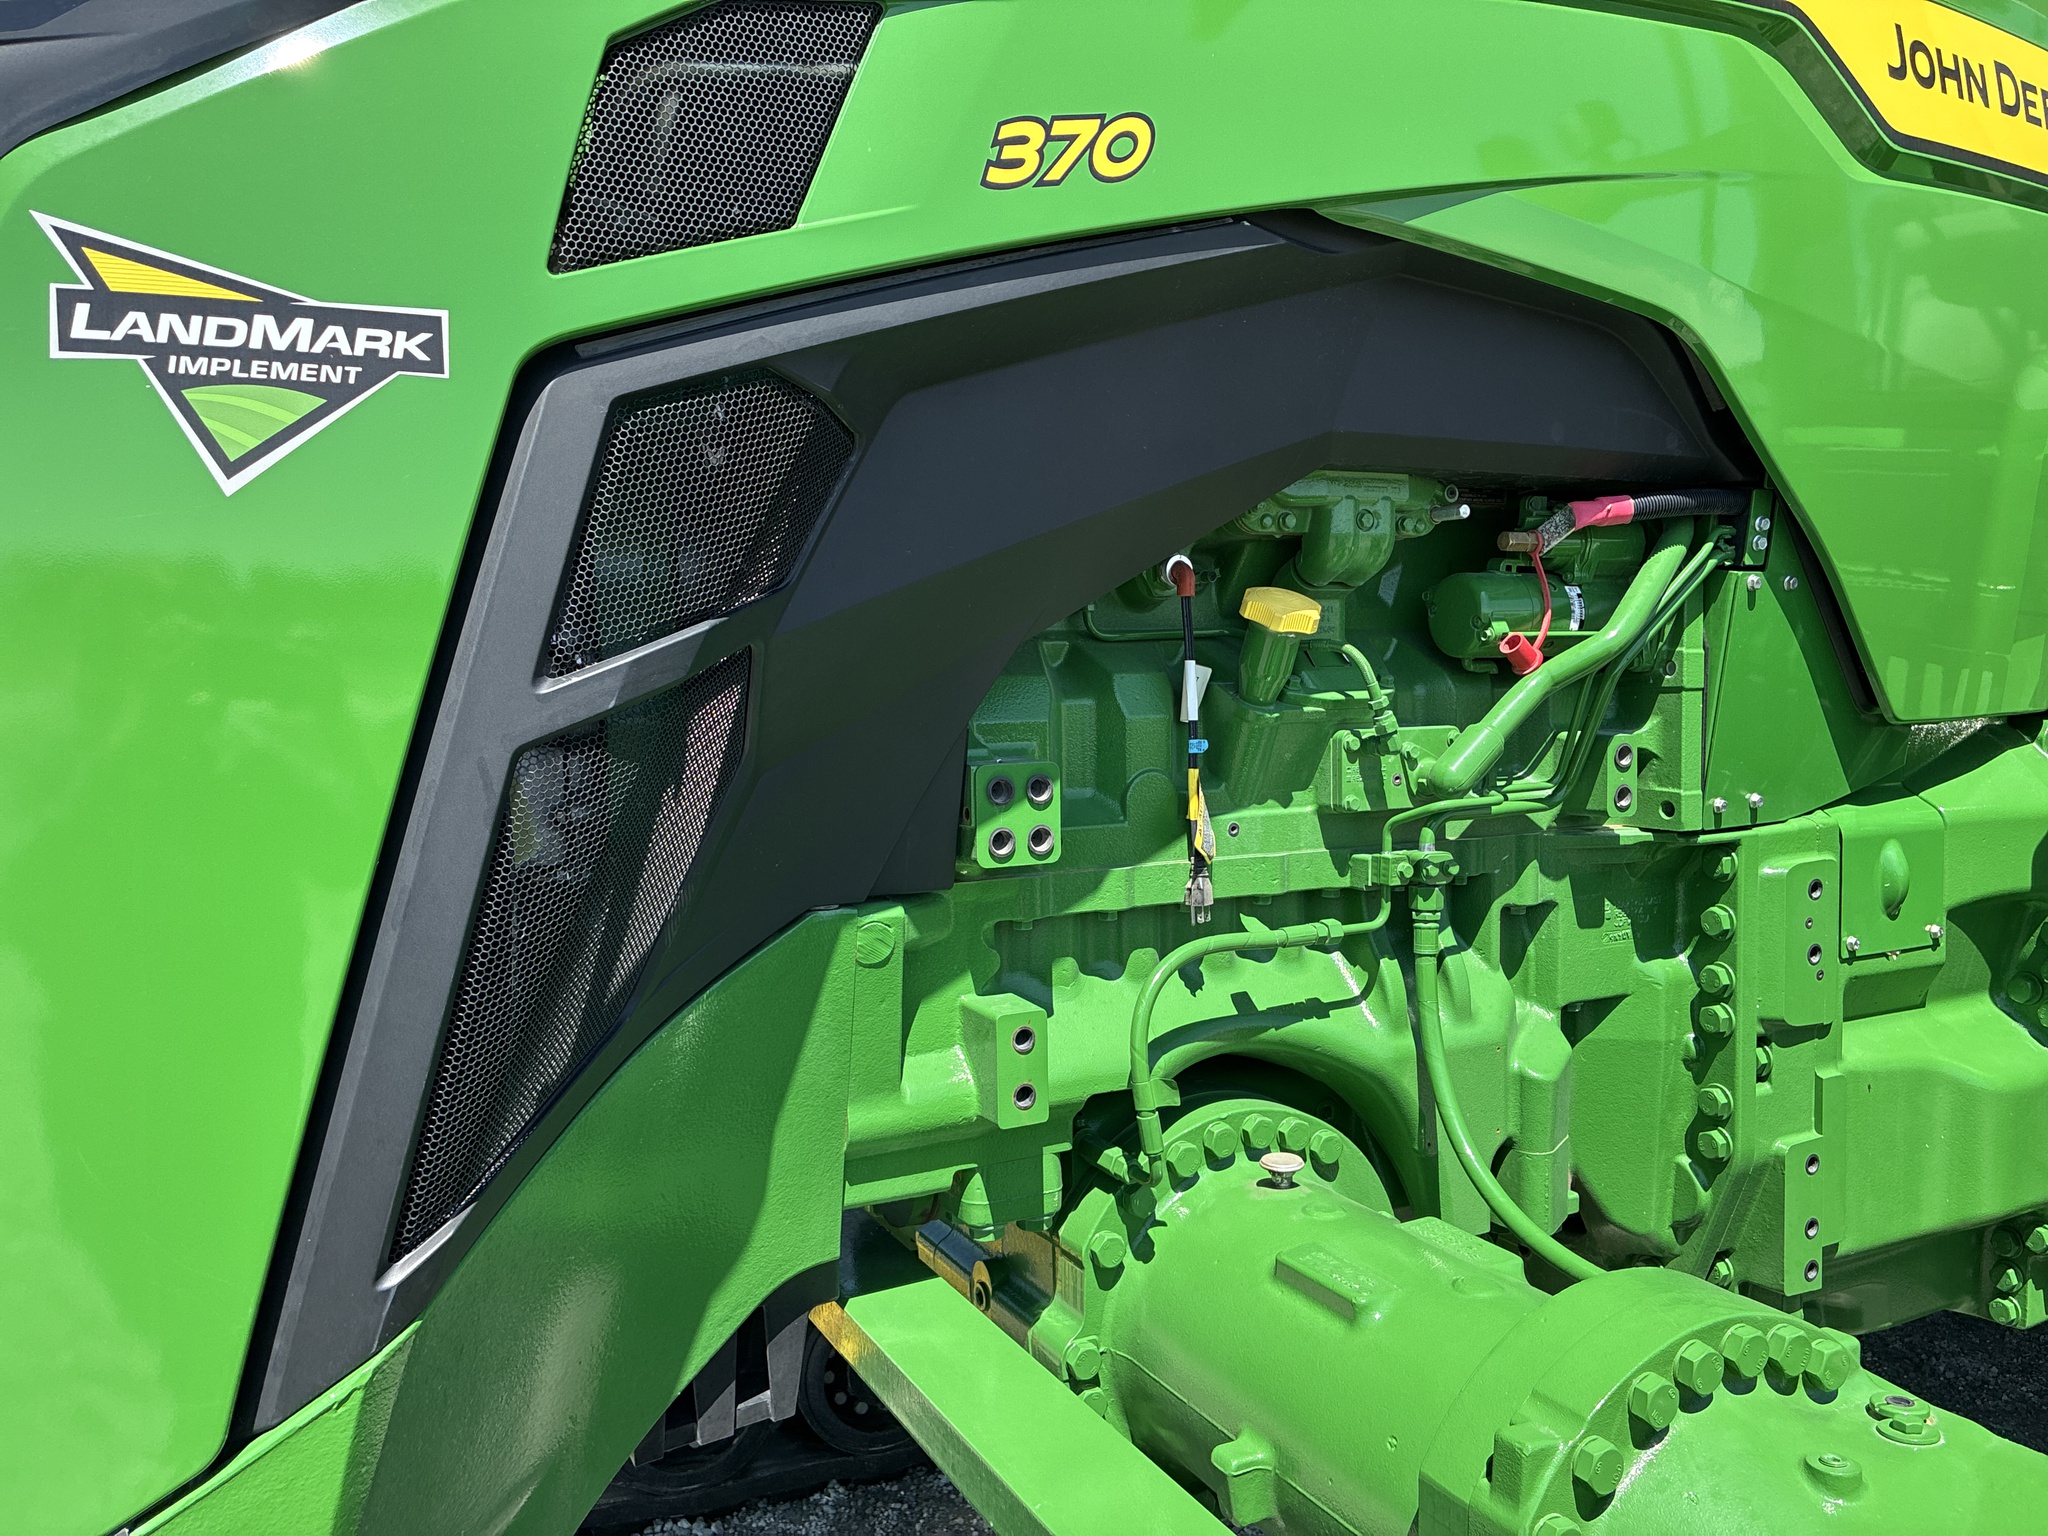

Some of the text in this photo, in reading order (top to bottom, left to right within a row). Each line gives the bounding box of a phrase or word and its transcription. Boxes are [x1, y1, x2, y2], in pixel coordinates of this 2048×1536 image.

[1886, 22, 1990, 109] JOHN
[980, 111, 1156, 190] 370
[69, 302, 433, 361] LANDMARK
[167, 354, 363, 384] IMPLEMENT
